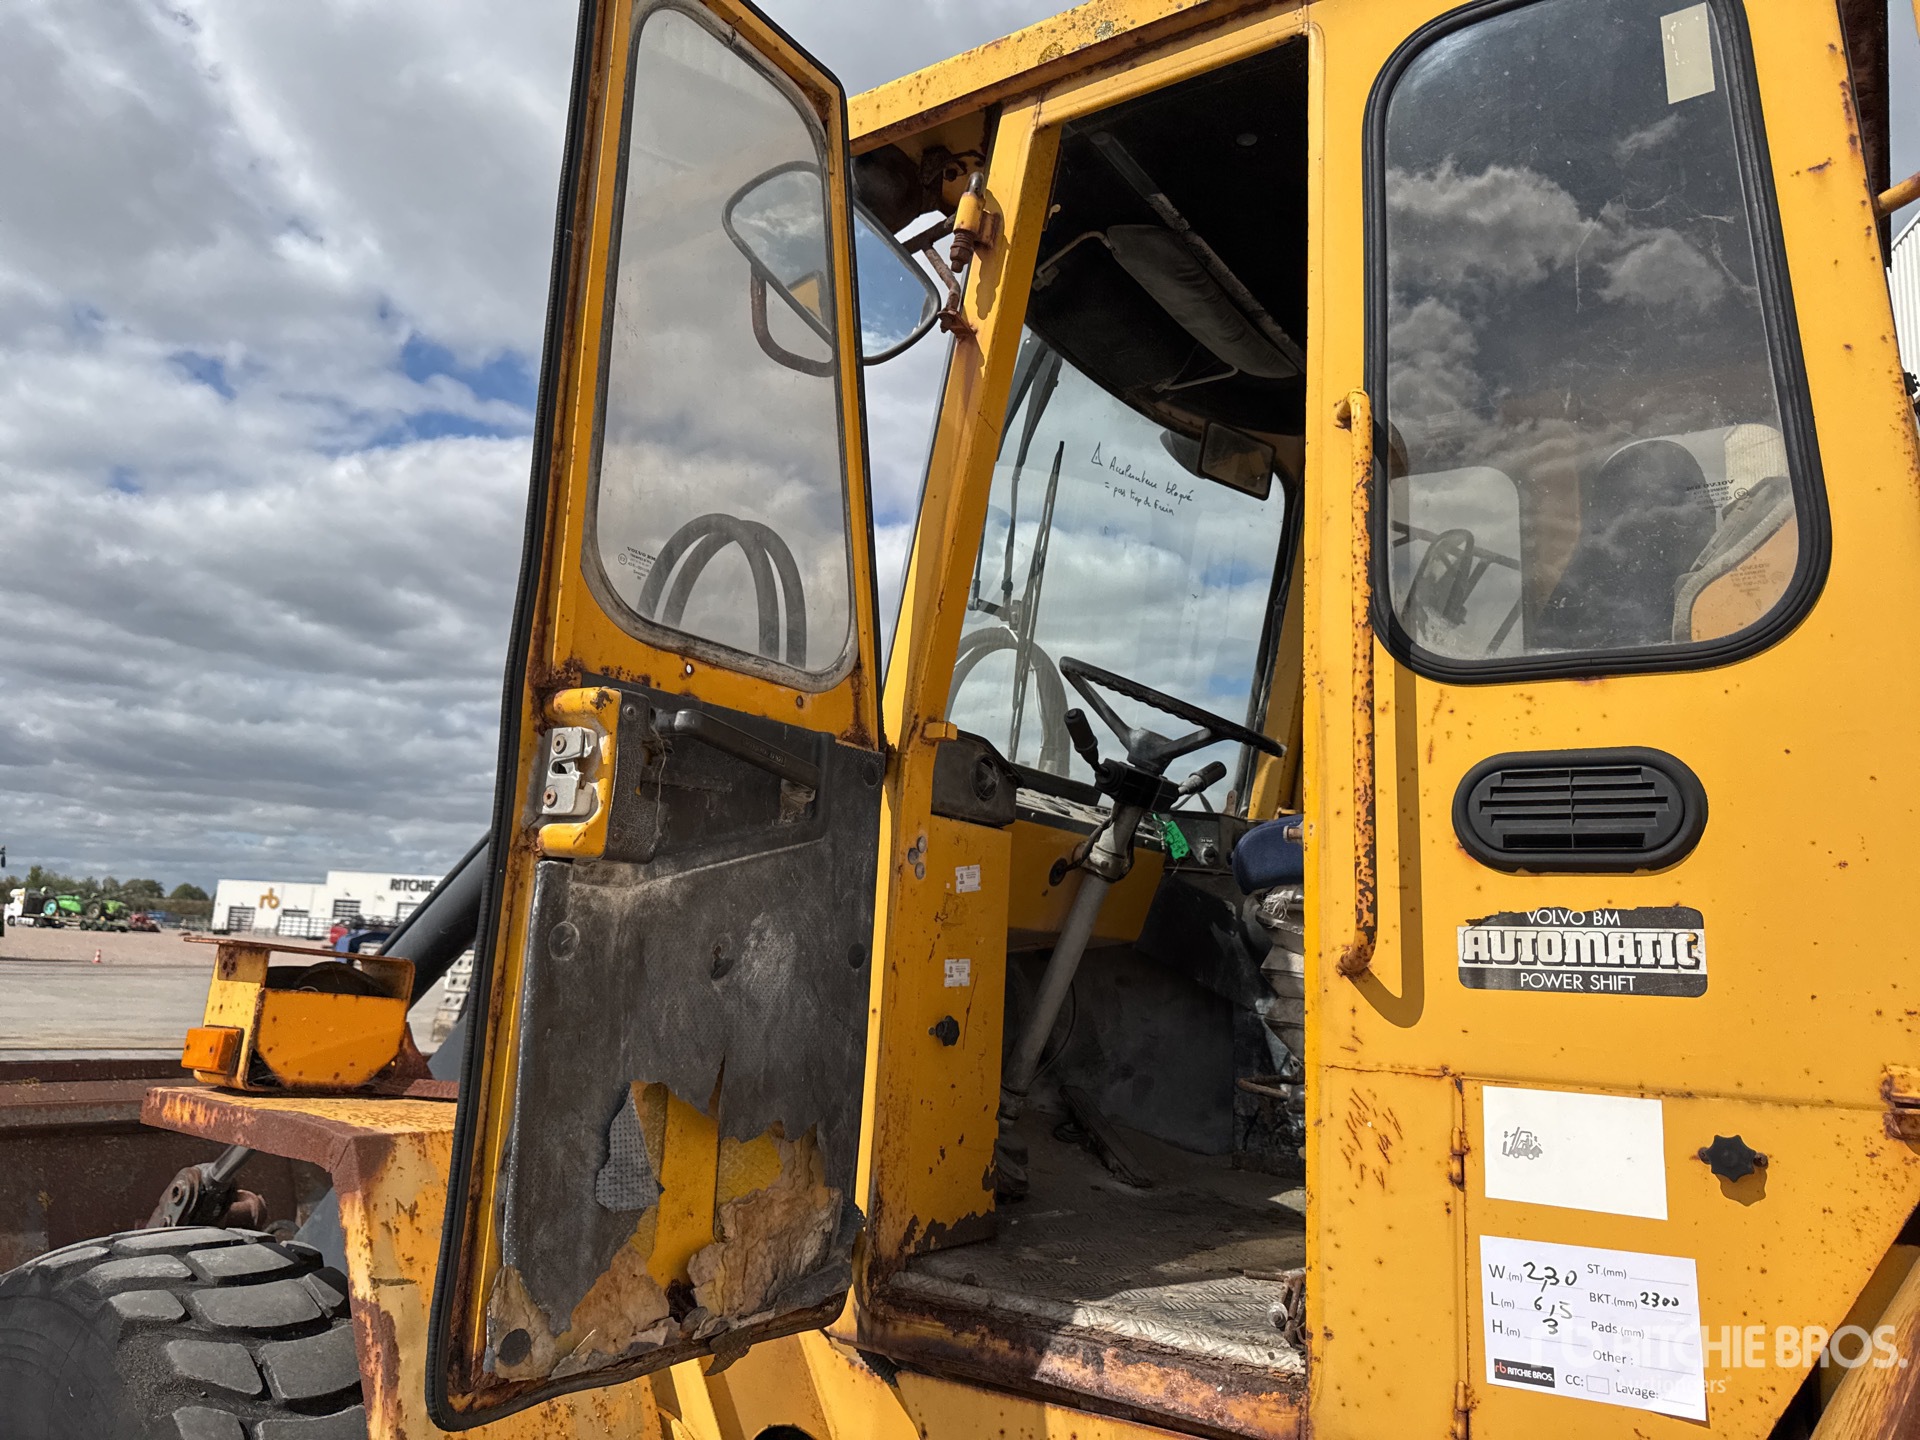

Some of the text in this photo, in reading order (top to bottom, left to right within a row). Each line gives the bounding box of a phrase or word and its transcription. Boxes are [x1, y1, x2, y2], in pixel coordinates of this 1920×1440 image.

[391, 878, 436, 892] RITCHIE
[259, 887, 280, 909] rb
[1526, 909, 1621, 926] VOLVO BM
[1462, 929, 1700, 970] AUTOMATIC
[1520, 972, 1636, 991] POWER SHIFT
[1640, 1291, 1680, 1308] 2300
[1542, 1318, 1559, 1335] 3
[1494, 1361, 1507, 1374] rb
[1507, 1367, 1532, 1378] RITCHIE
[1565, 1374, 1584, 1387] CC:
[1615, 1381, 1659, 1400] Lavage:
